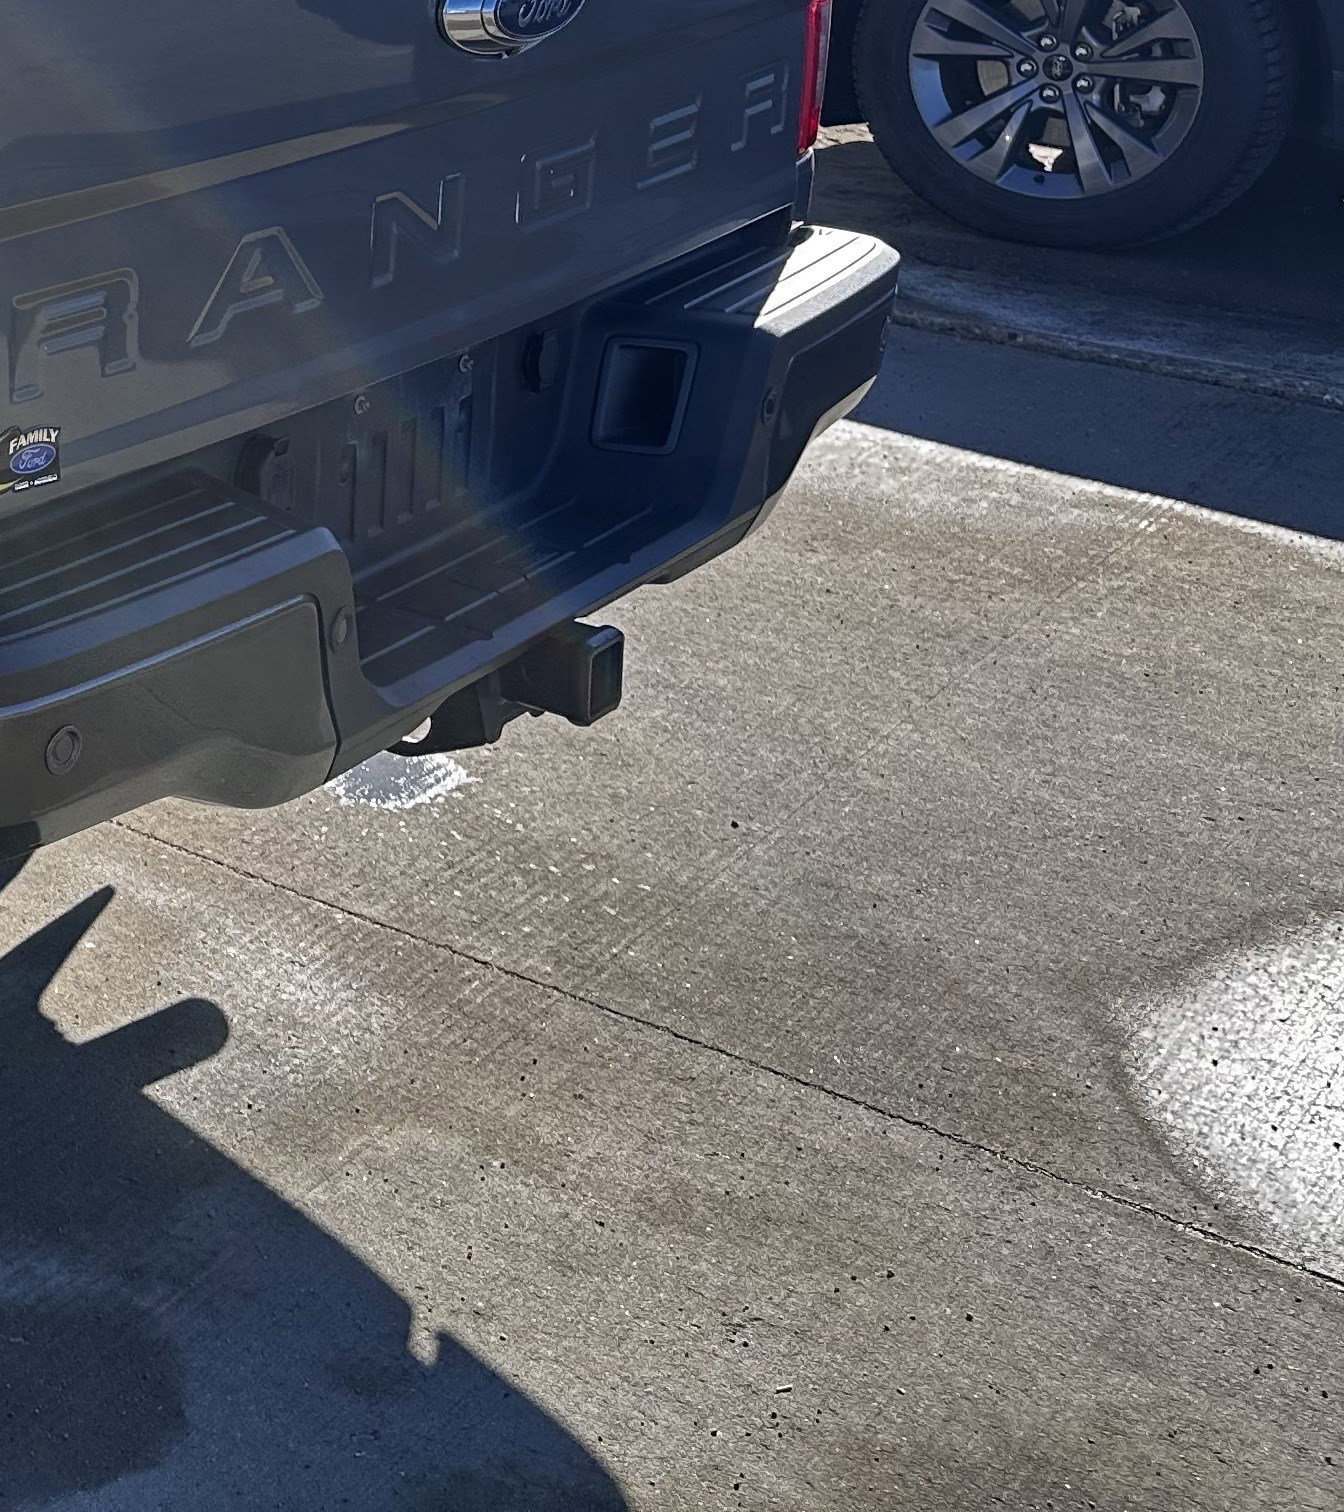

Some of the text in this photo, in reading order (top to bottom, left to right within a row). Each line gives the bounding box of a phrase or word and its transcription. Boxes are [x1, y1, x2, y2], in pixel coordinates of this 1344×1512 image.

[7, 58, 789, 404] RANGER
[8, 427, 59, 455] FAMILY
[18, 447, 47, 470] Ford
